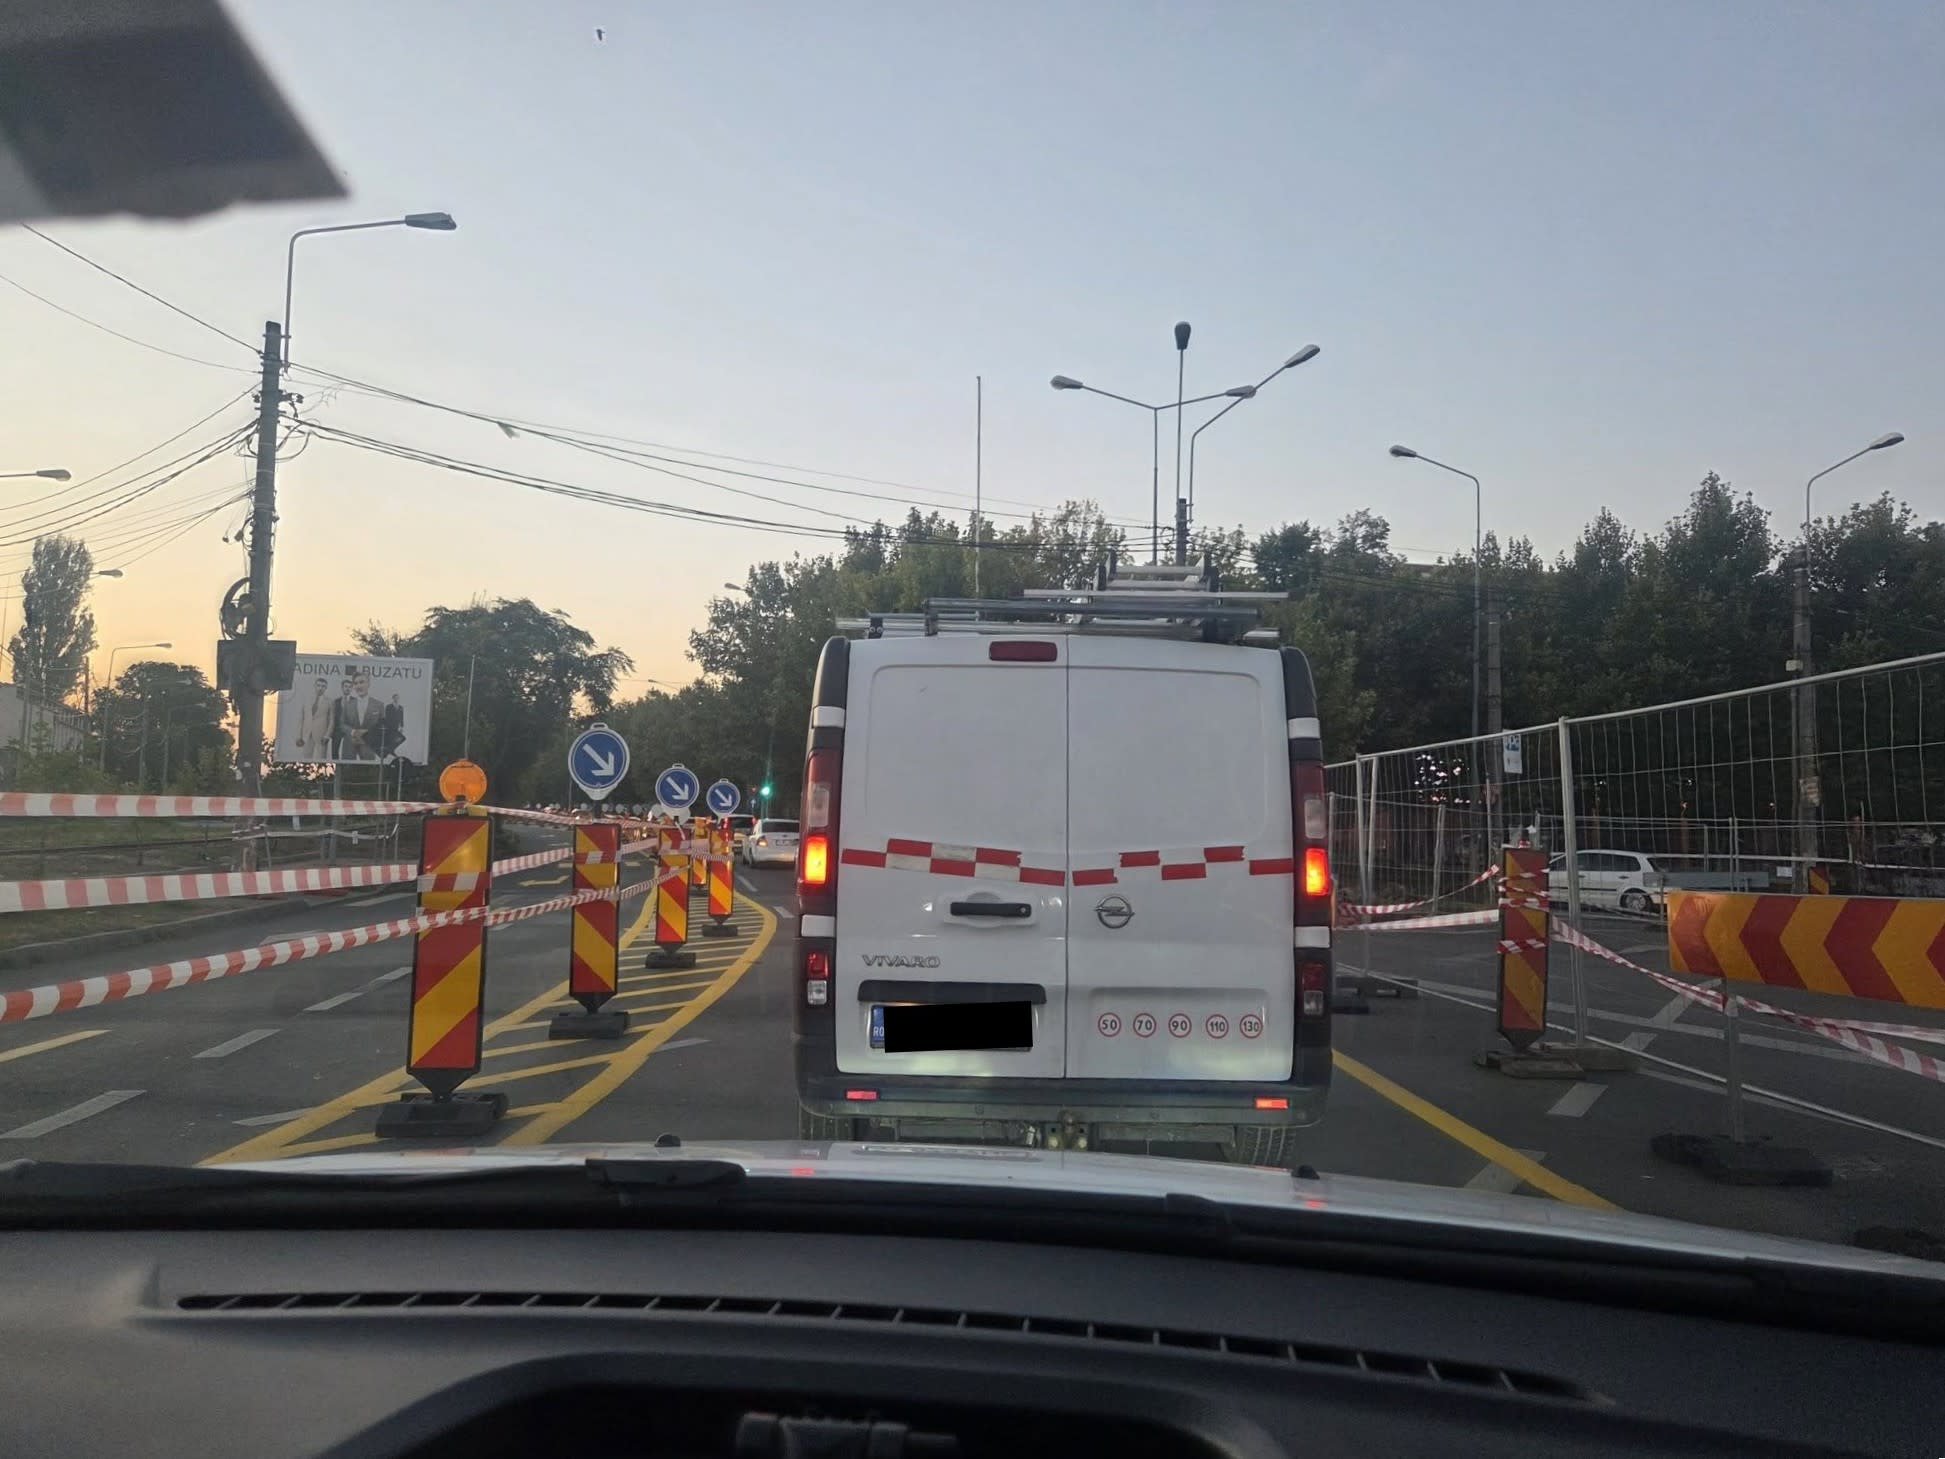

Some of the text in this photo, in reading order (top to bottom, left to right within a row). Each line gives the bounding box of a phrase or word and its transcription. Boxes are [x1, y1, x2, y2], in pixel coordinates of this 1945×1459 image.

[294, 663, 422, 679] ADINA BUZATU
[862, 954, 941, 968] VIVARO
[873, 1026, 884, 1037] RO
[1102, 1019, 1259, 1032] 50 70 90 110 130
